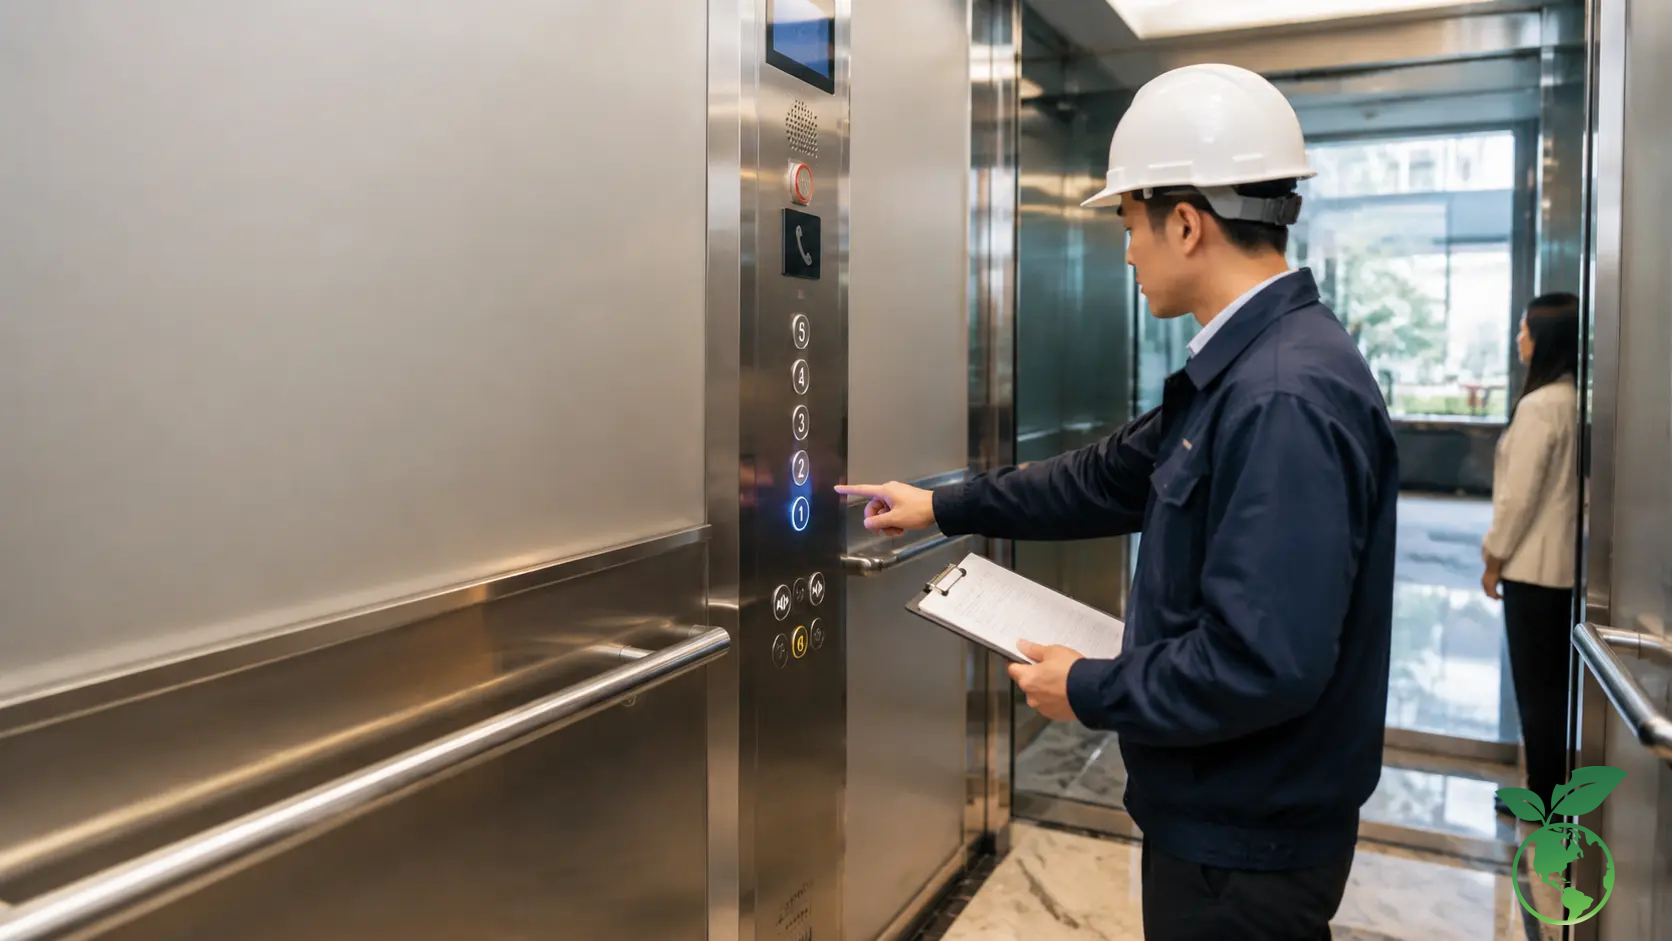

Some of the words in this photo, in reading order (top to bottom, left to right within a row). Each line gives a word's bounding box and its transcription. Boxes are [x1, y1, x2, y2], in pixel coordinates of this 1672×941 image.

[798, 322, 806, 342] 5
[798, 367, 805, 387] 4
[798, 413, 805, 433] 3
[798, 458, 805, 479] 2
